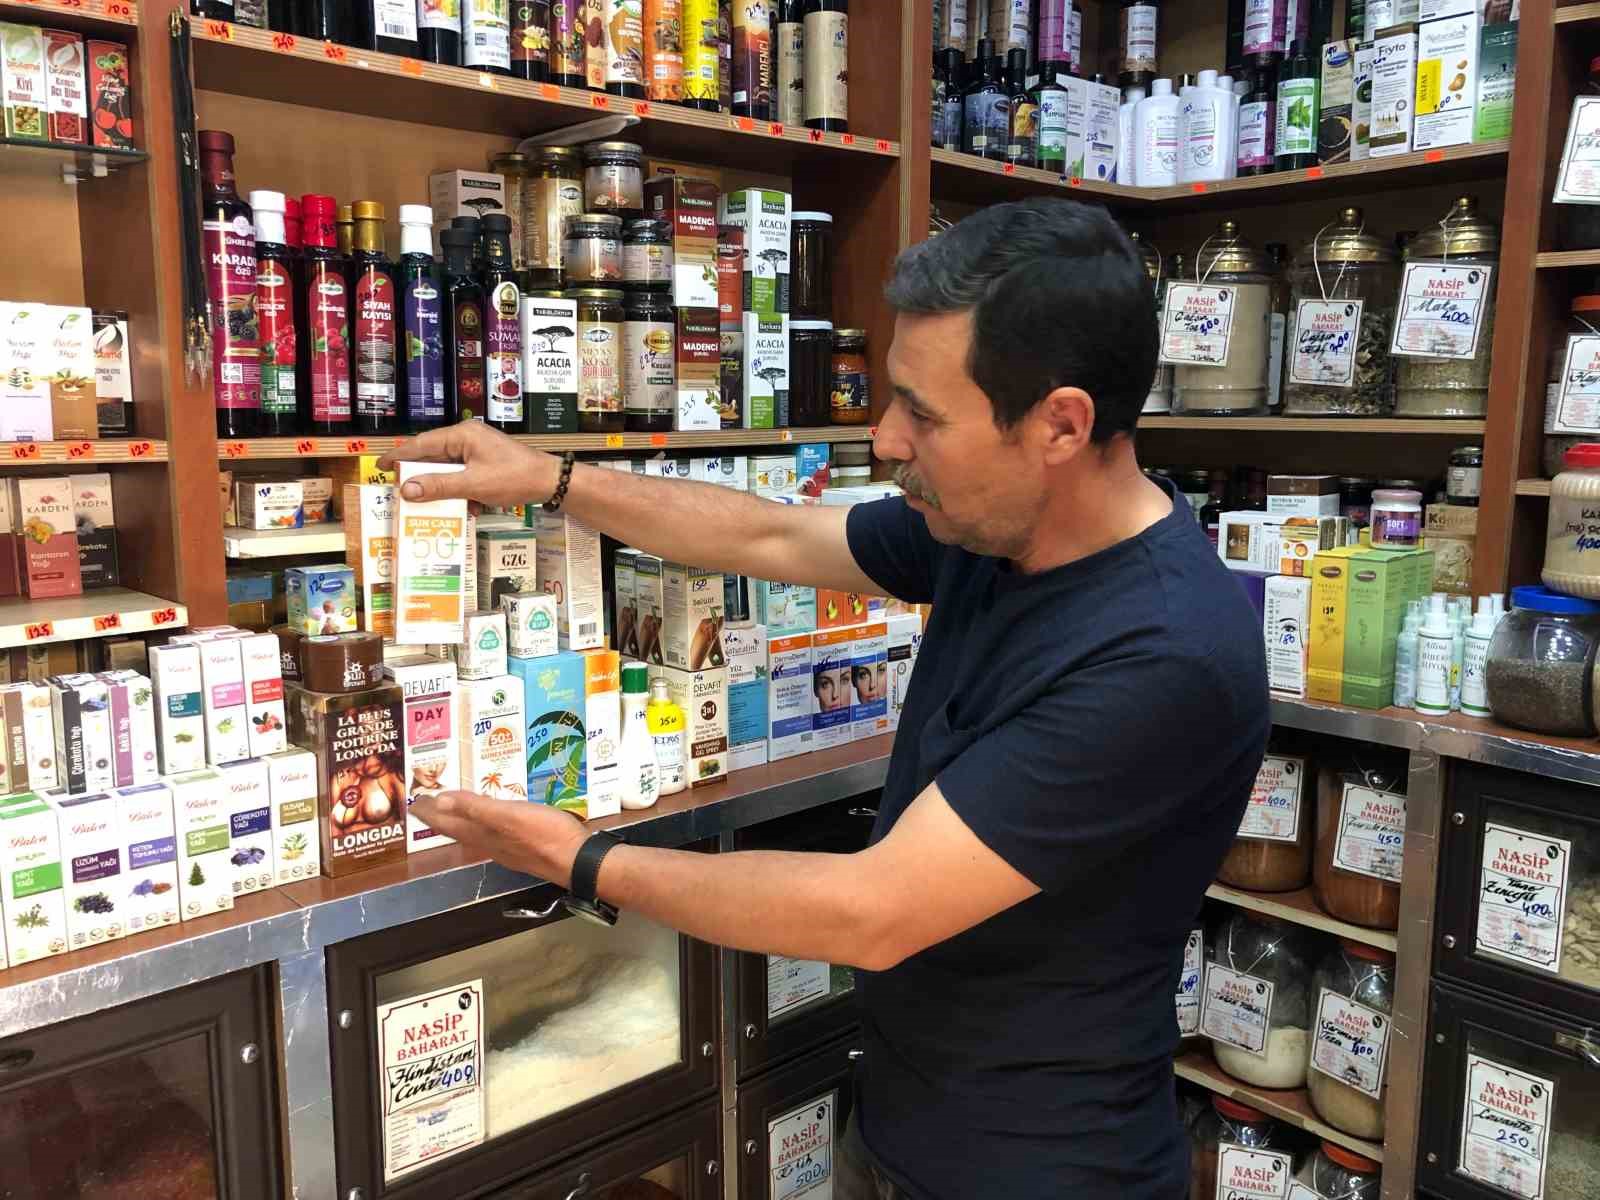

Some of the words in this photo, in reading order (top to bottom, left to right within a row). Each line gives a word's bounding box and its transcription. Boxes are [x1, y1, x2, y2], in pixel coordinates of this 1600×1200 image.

[107, 5, 130, 15] 100
[679, 215, 715, 226] MADENCİ
[759, 219, 788, 231] ACACIA
[212, 253, 257, 266] KARADU
[1428, 277, 1465, 290] NASİP
[1186, 295, 1217, 305] NASİP
[1422, 288, 1467, 299] BAHARAT
[362, 311, 392, 321] KAYISI
[1314, 312, 1343, 322] NASİP
[683, 342, 719, 352] MADENCİ
[756, 339, 785, 349] ACACIA
[537, 357, 571, 368] ACACIA
[15, 444, 36, 458] 120
[70, 443, 91, 457] 120
[130, 443, 150, 456] 120
[27, 505, 70, 514] KARDEN
[75, 500, 109, 509] ARDEN
[99, 615, 118, 629] 125
[154, 608, 177, 624] 125
[27, 624, 50, 639] 125
[338, 716, 355, 727] LA
[358, 709, 391, 723] PLUS
[414, 708, 444, 722] DAY
[337, 720, 394, 738] GRANDE
[333, 731, 399, 751] POITRINE
[335, 747, 369, 763] LONG
[377, 743, 396, 755] DA
[1258, 767, 1282, 779] ASİP
[1364, 801, 1401, 816] NASİP
[333, 823, 404, 851] LONGDA
[1377, 833, 1401, 845] 450
[1498, 847, 1550, 869] NASİP
[1492, 860, 1554, 882] BAHARAT
[1338, 1009, 1370, 1027] NASİP
[403, 1012, 464, 1045] NASİP
[396, 1029, 470, 1061] BAHARAT
[390, 1048, 475, 1089] Hindistan
[441, 1065, 474, 1088] 400
[1484, 1081, 1534, 1107] NASİP
[1479, 1093, 1537, 1121] BAHARAT
[1472, 1108, 1535, 1135] Lavanta
[781, 1122, 820, 1151] NASİP
[1496, 1128, 1530, 1149] 250
[777, 1135, 825, 1165] BAHARAT
[1233, 1165, 1276, 1182] NASİP
[1229, 1178, 1277, 1193] BAHARAT
